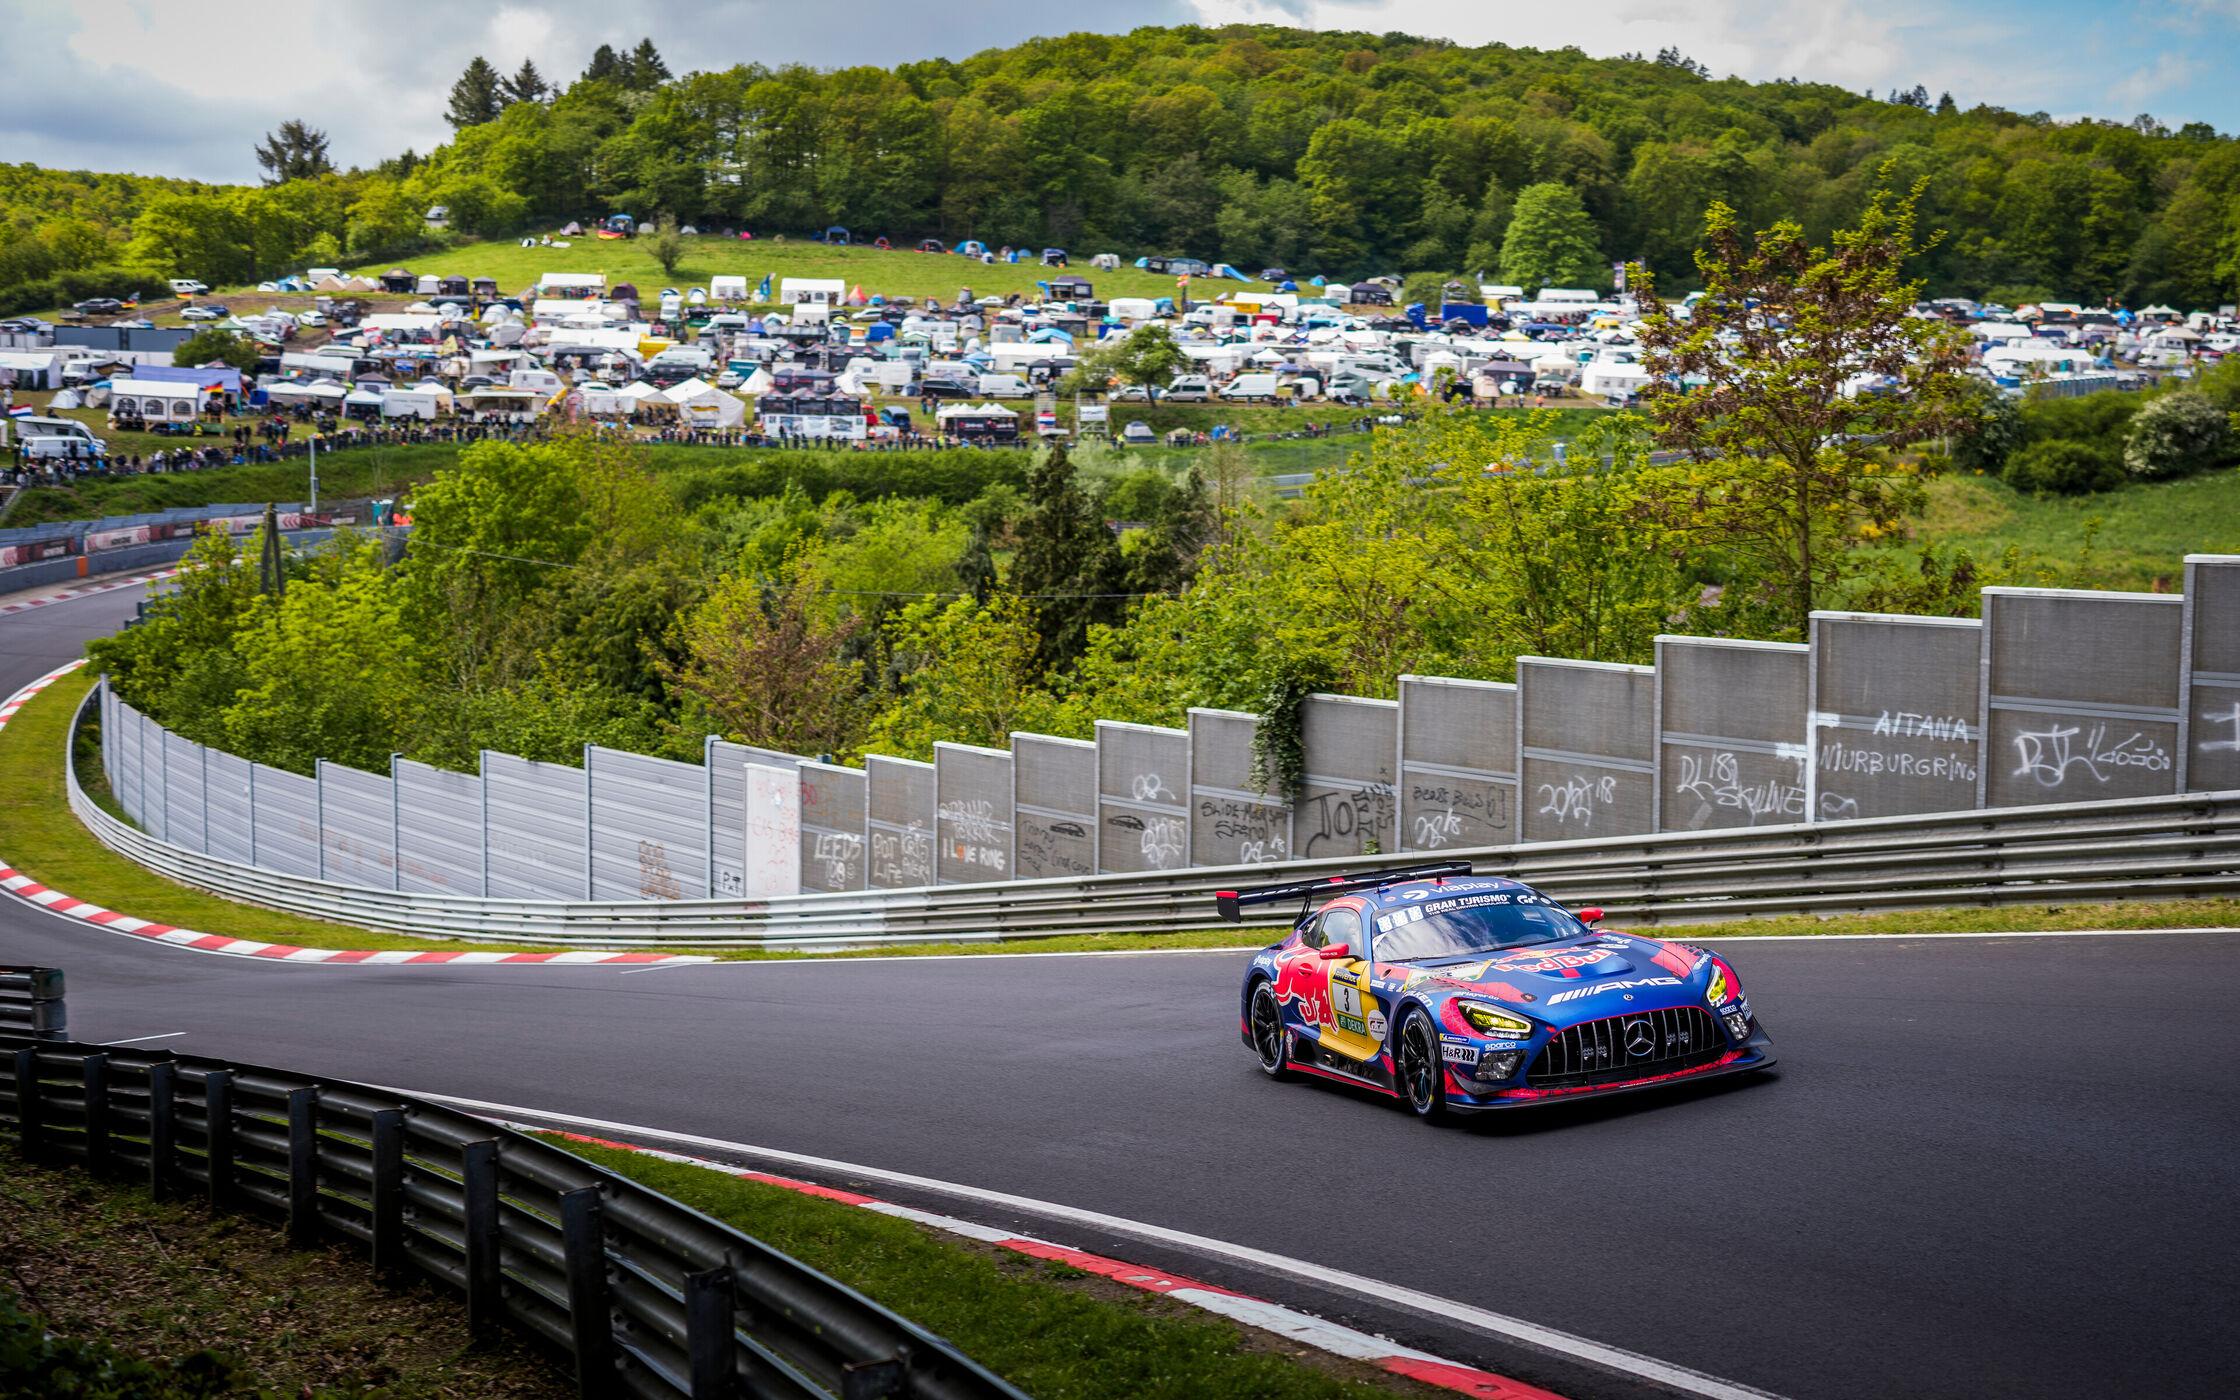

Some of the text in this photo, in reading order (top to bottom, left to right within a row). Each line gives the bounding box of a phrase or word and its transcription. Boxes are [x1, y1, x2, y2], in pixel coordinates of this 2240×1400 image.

[1872, 710, 1969, 744] AITANA
[1425, 894, 1508, 913] GRAN TURISMO
[1593, 977, 1683, 994] AMG
[1344, 988, 1350, 1012] 3
[1347, 1017, 1366, 1035] DEKRA
[1442, 1046, 1461, 1059] H&R
